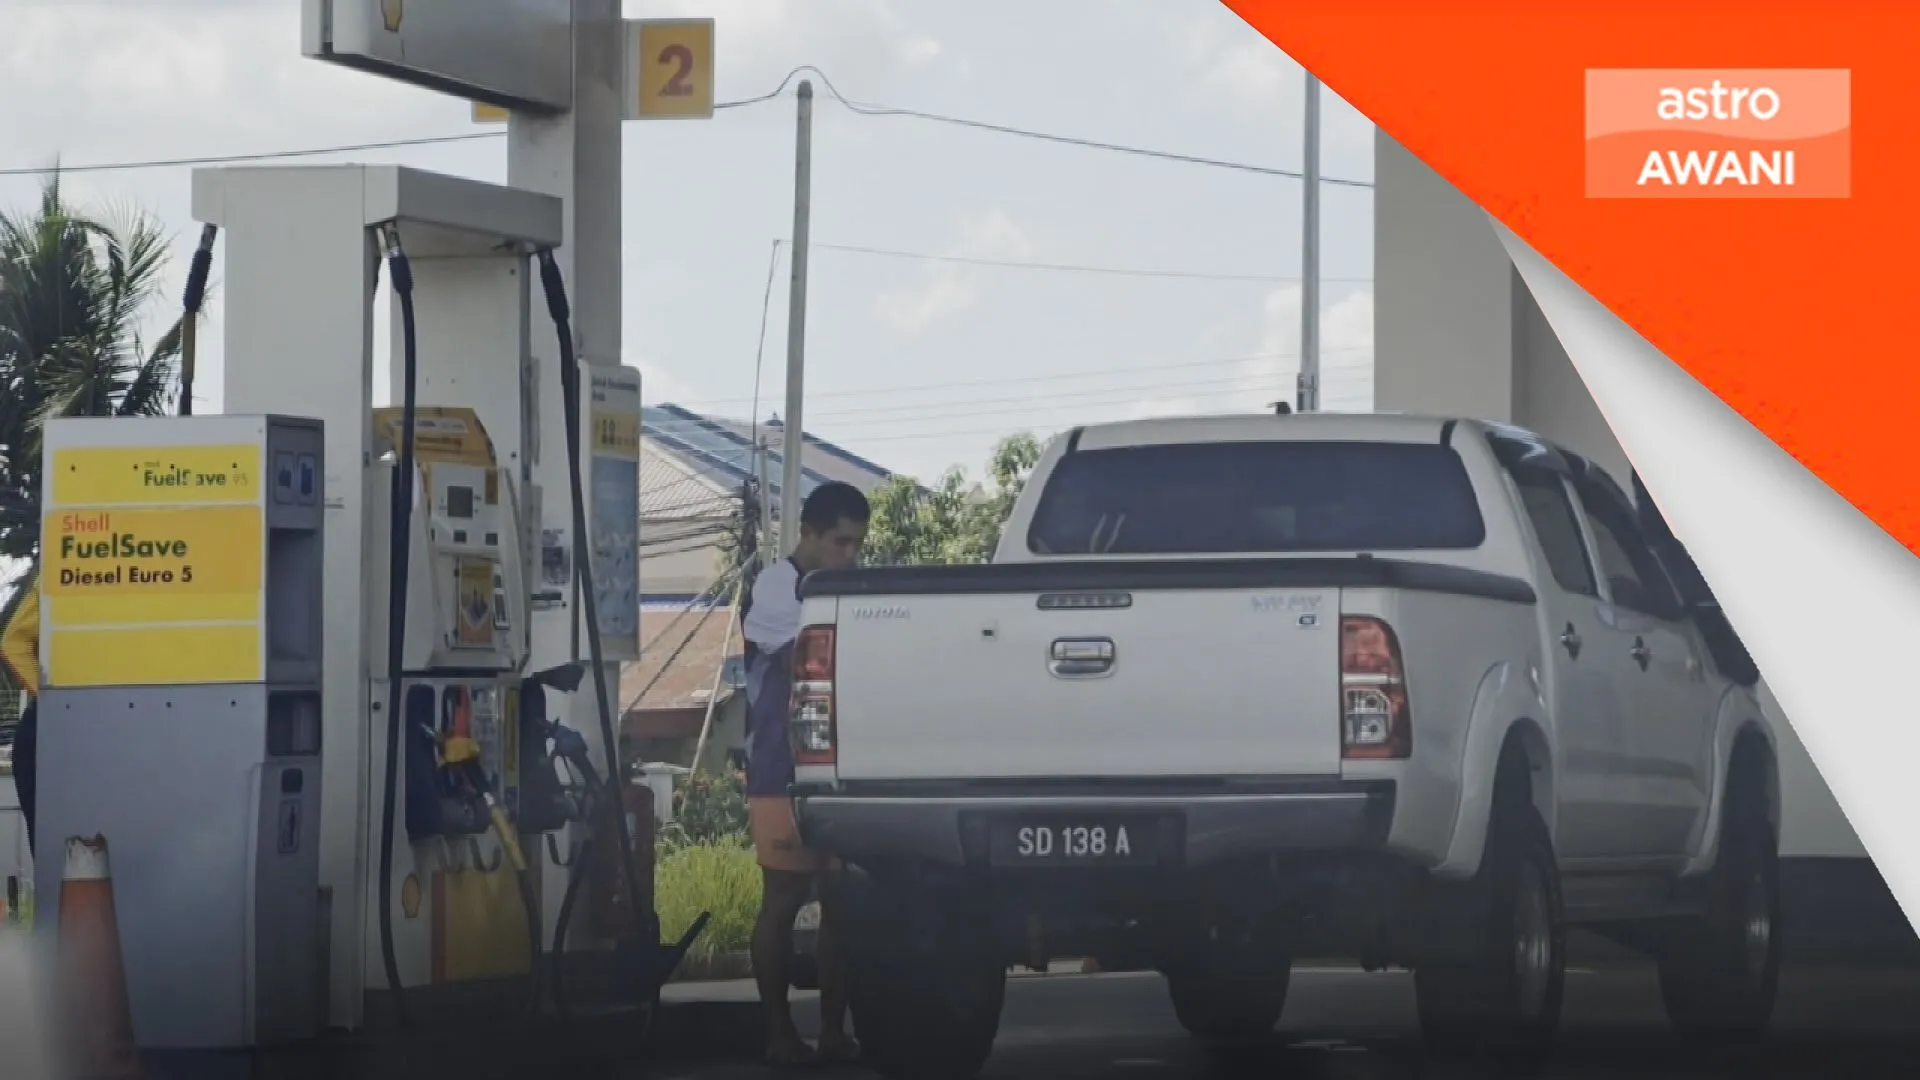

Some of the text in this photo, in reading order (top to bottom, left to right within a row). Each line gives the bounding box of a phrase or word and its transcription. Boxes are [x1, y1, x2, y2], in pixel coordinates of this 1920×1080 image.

[657, 44, 694, 97] 2
[62, 514, 110, 532] Shell
[61, 532, 187, 558] FuelSave
[60, 565, 193, 585] Diesel Euro 5
[1019, 825, 1130, 855] SD 138 A
